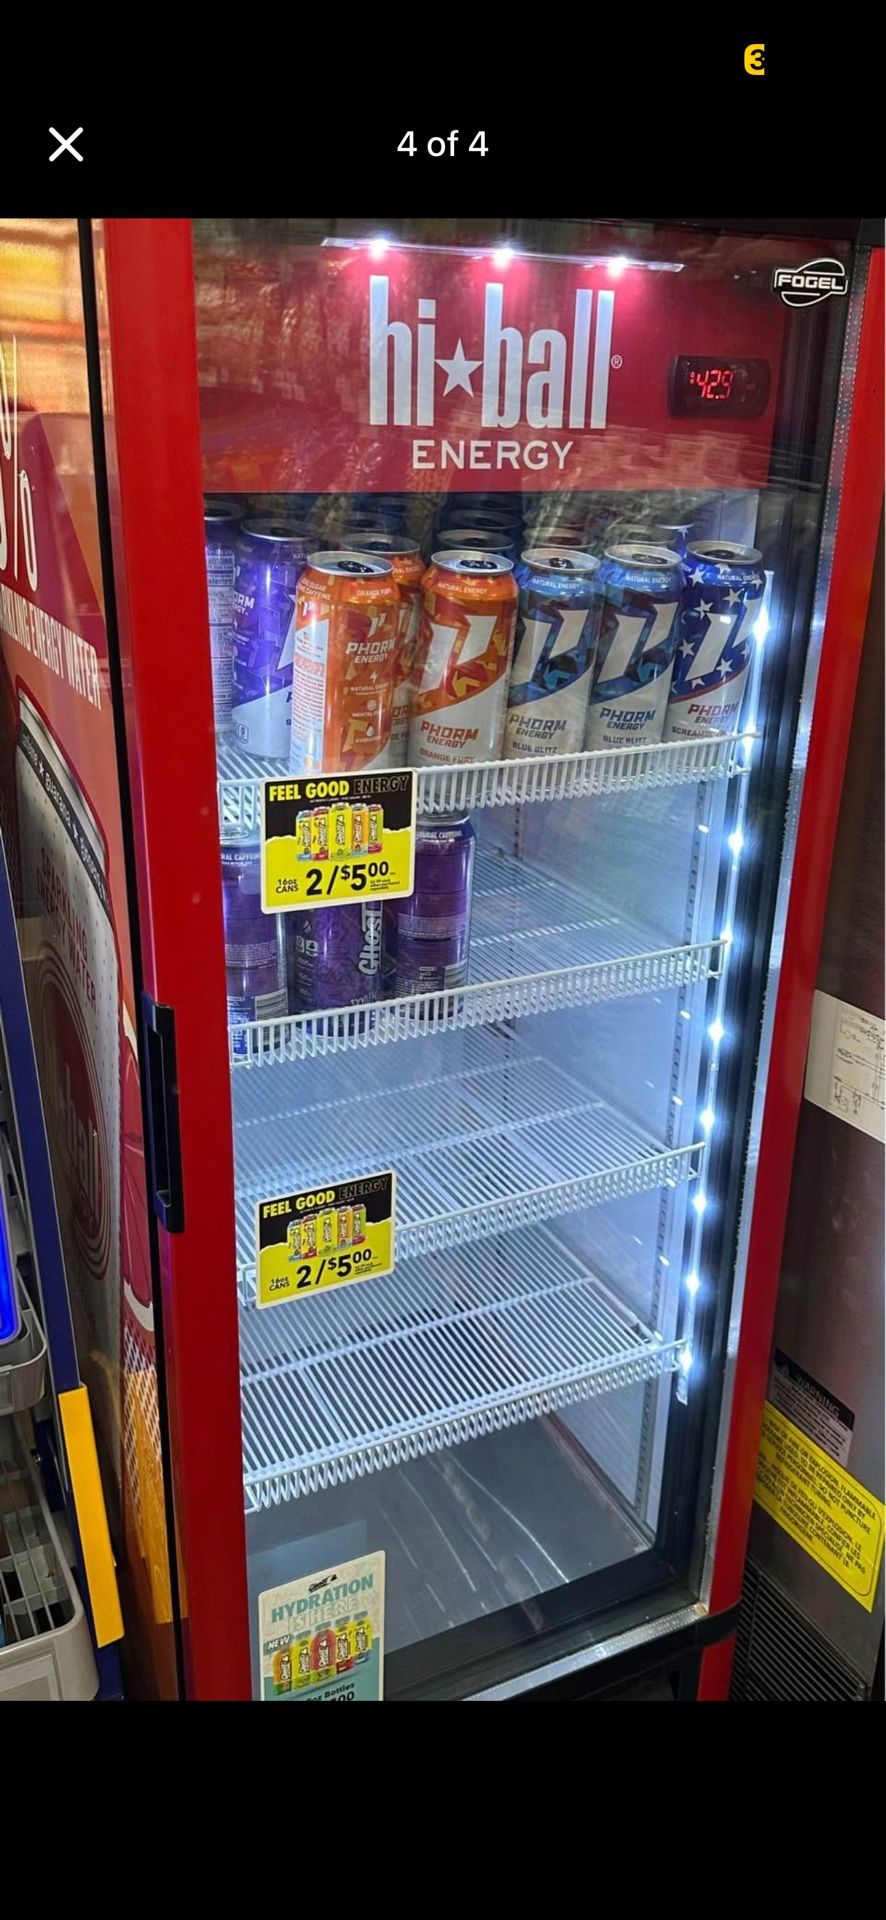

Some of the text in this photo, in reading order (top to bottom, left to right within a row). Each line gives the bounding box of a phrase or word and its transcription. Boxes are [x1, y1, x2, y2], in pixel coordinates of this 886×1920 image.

[777, 274, 844, 291] FOGEL
[412, 439, 574, 470] ENERGY
[345, 638, 396, 655] PHORM
[29, 601, 64, 680] ENERGY
[62, 625, 102, 711] WATER
[353, 654, 389, 664] ENERGY
[599, 707, 656, 721] PHORM
[688, 703, 740, 718] PHORM
[509, 714, 568, 732] PHORM
[606, 720, 645, 731] ENERGY
[420, 720, 479, 742] PHORM
[515, 727, 555, 740] ENERGY
[426, 735, 467, 749] ENERGY
[602, 735, 624, 743] BLUE
[512, 741, 532, 753] BLUE
[419, 747, 451, 763] ORANGE
[269, 784, 302, 802] FEEL
[305, 780, 350, 799] GOOD
[353, 774, 410, 796] ENERGY
[276, 885, 299, 894] CANS
[263, 1200, 292, 1219] FEEL
[295, 1190, 336, 1210] GOOD
[339, 1176, 389, 1201] ENERGY
[269, 1281, 290, 1292] CANS
[271, 1573, 374, 1623] HYDRATION
[267, 1635, 291, 1650] NEW
[325, 1683, 355, 1699] Bottles
